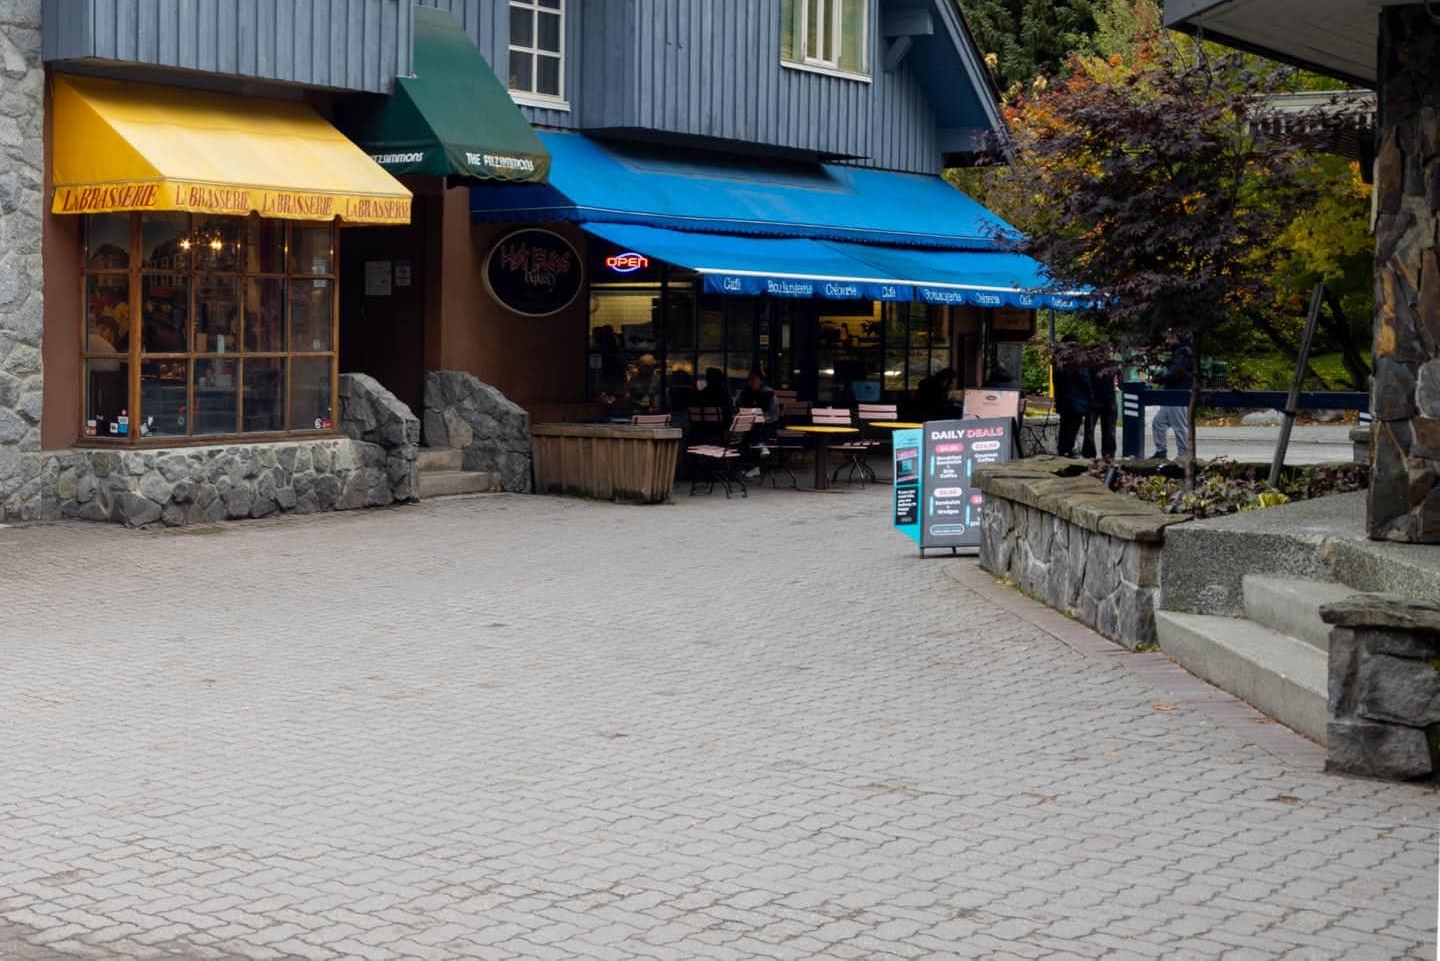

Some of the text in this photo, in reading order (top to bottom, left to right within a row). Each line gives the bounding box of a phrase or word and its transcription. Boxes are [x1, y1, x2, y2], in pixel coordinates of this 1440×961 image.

[606, 256, 648, 268] OPEN
[931, 427, 1004, 439] DAILY DEALS
